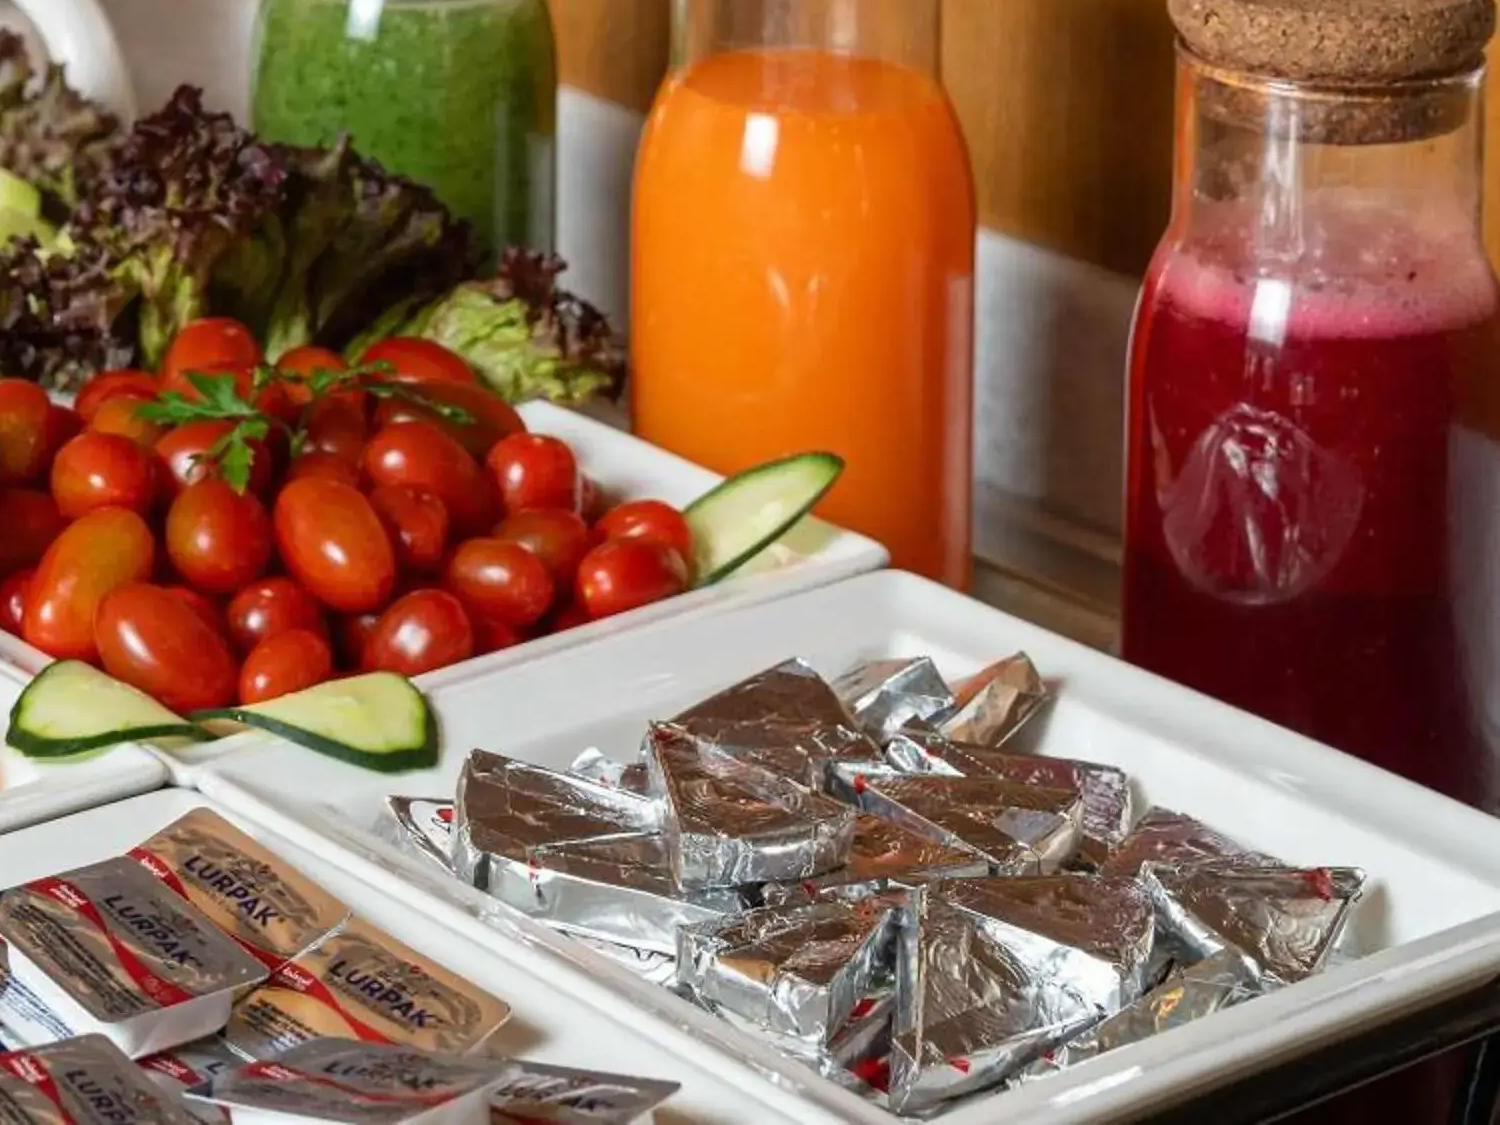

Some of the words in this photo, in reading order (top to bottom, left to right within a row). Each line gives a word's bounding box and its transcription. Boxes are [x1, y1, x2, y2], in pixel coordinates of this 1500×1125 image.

[184, 854, 279, 927] LURPAK
[104, 894, 194, 967] LURPAK
[328, 960, 437, 1028] LURPAK
[65, 1069, 129, 1125] LURP
